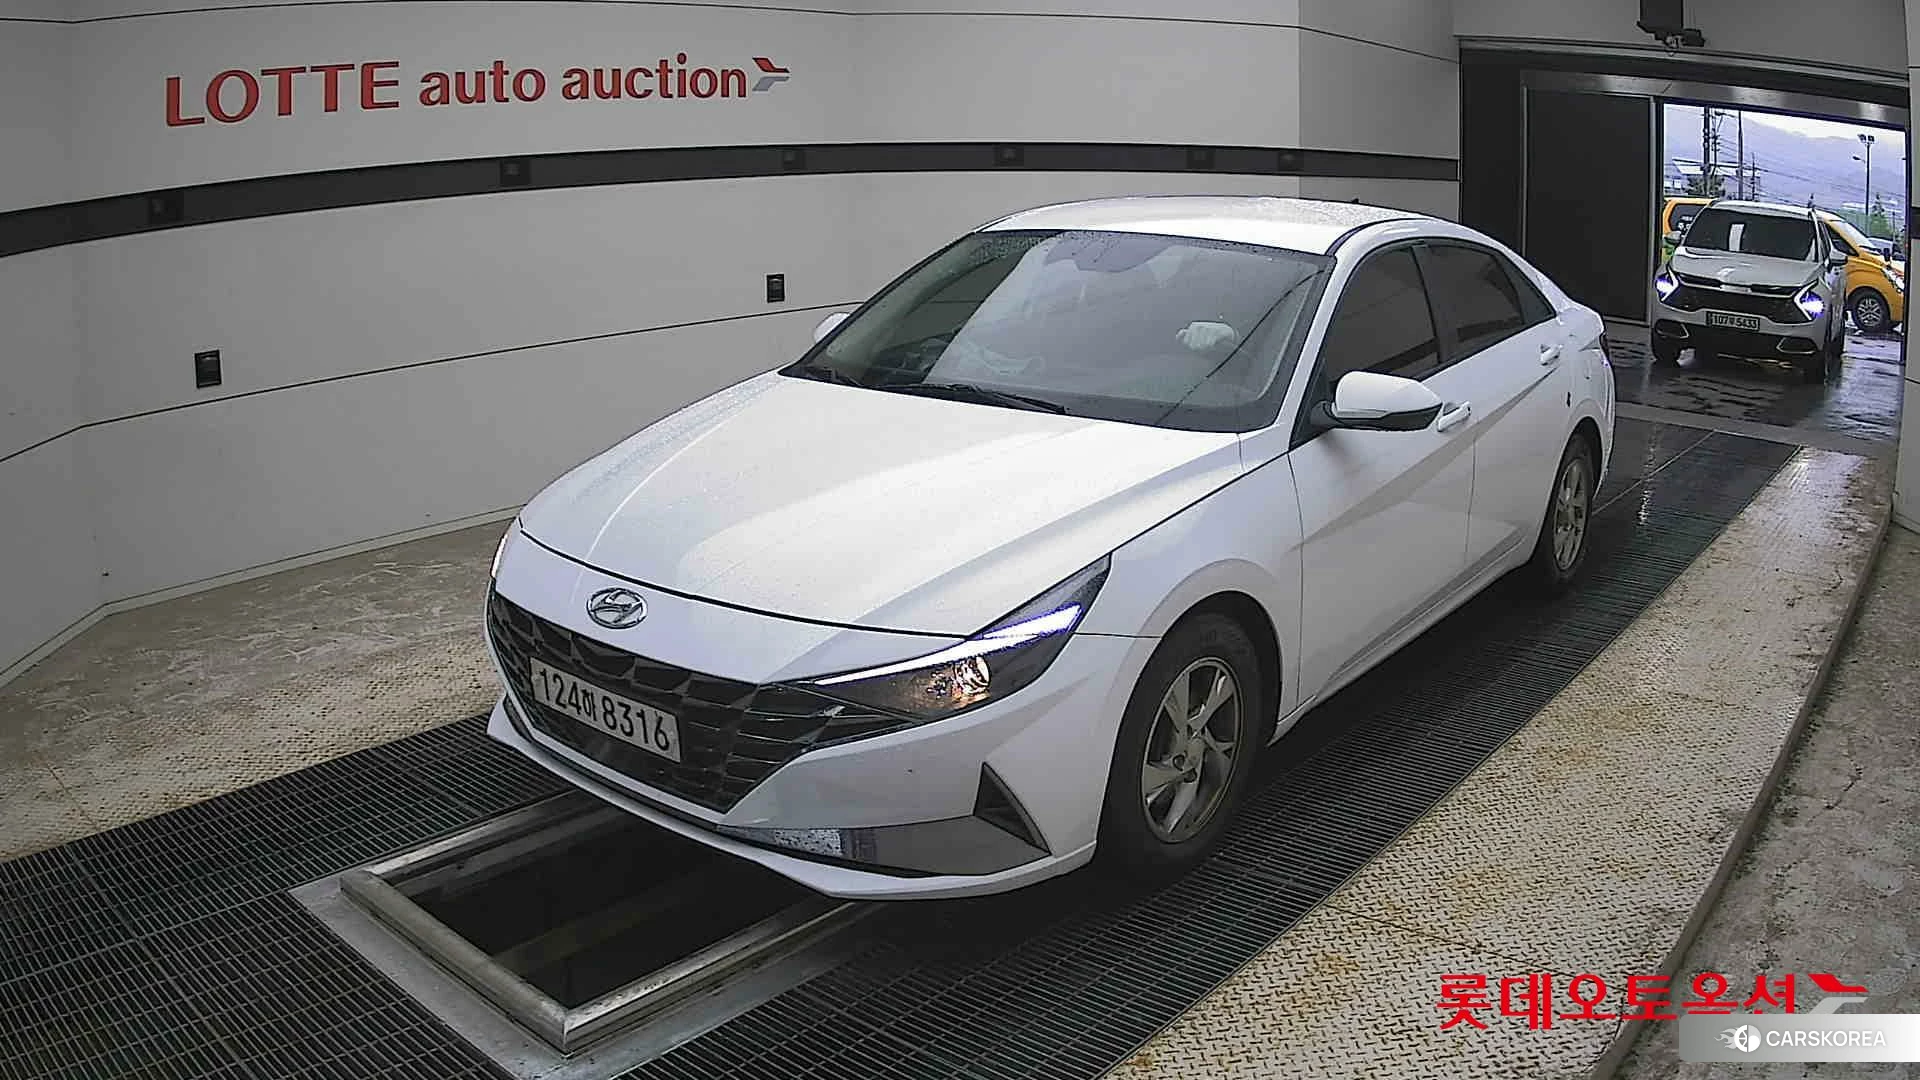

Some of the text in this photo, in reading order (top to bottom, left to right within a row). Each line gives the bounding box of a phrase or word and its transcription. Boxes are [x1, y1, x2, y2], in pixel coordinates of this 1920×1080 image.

[167, 54, 747, 126] LOTTE auto auction
